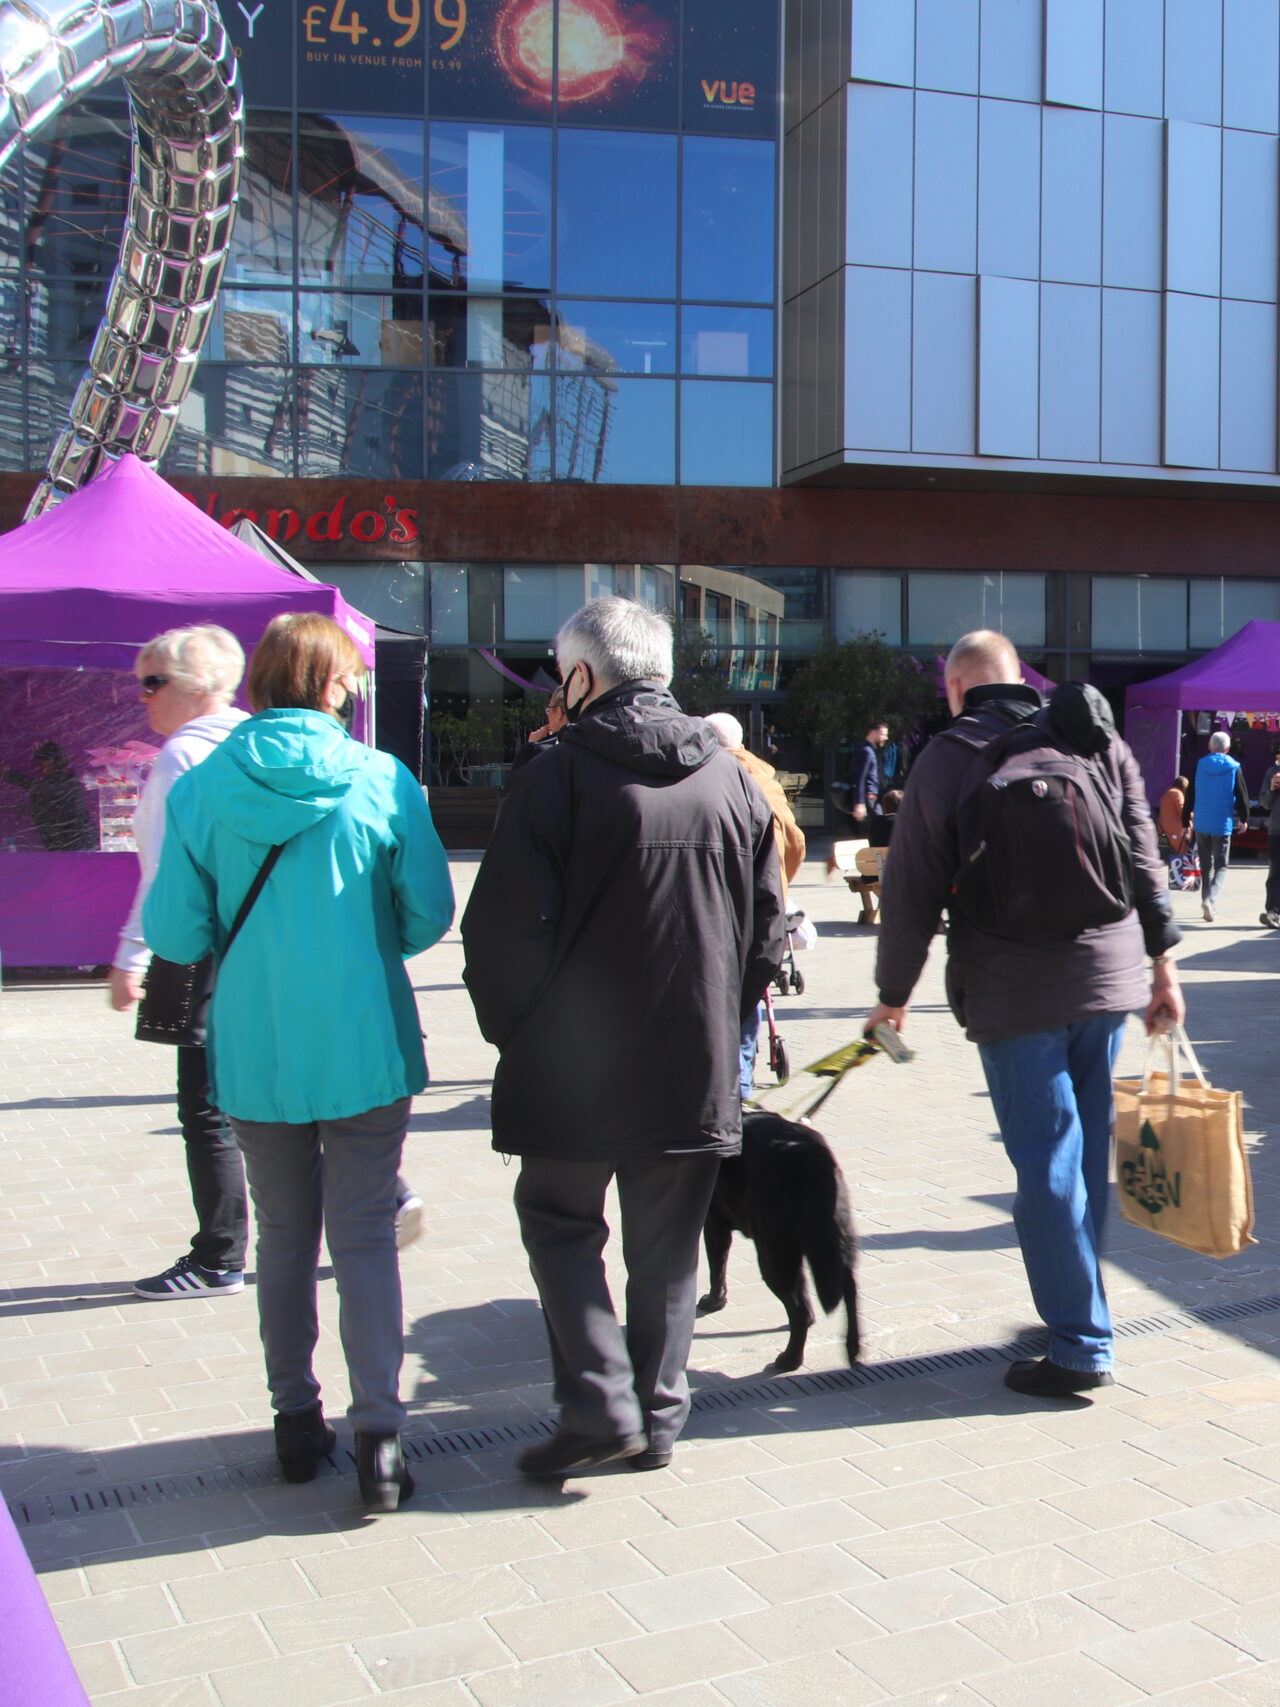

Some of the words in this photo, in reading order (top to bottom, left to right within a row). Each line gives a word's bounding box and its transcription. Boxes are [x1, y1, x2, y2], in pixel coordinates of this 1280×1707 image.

[302, 0, 468, 50] £4.99
[306, 51, 329, 63] BUY
[333, 54, 346, 64] IN
[350, 55, 387, 66] VENUE
[391, 57, 422, 68] FROM
